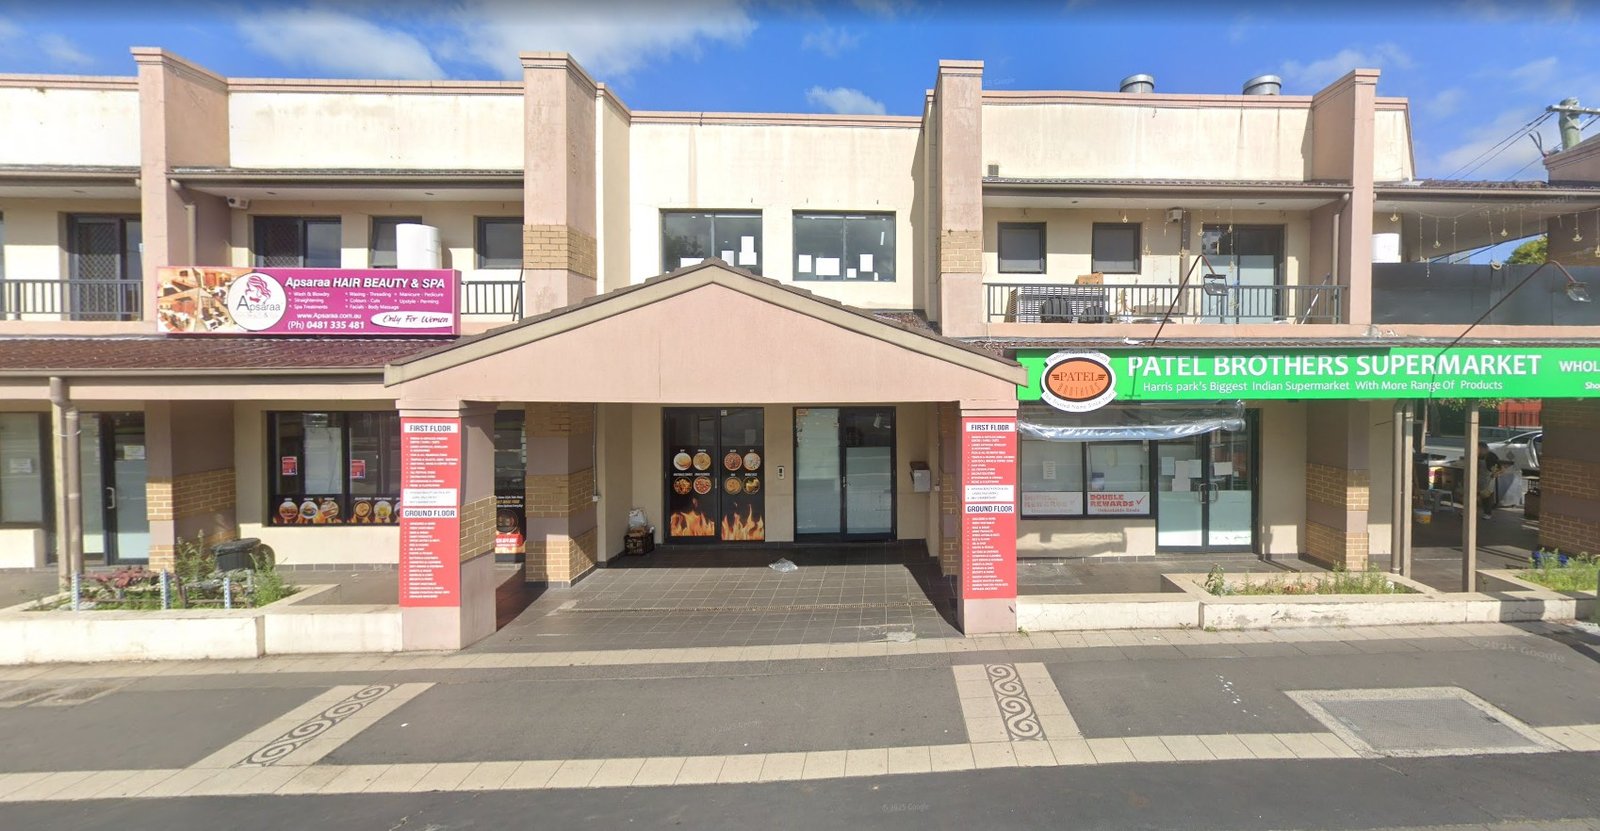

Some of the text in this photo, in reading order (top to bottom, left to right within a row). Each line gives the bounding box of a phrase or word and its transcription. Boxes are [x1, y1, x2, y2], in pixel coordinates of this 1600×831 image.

[286, 277, 445, 289] Apsaraa HAIR BEAUTY & SPA
[237, 295, 280, 312] Apsaraa
[288, 321, 304, 330] (Ph)
[383, 315, 401, 324] Only
[1128, 355, 1208, 376] PATEL
[1214, 355, 1349, 376] BROTHERS
[1356, 354, 1542, 376] SUPERMARKET
[1060, 372, 1098, 381] PATEL
[1143, 380, 1503, 394] Harris park's Biggest Indian Supermarket With More Range Of Products
